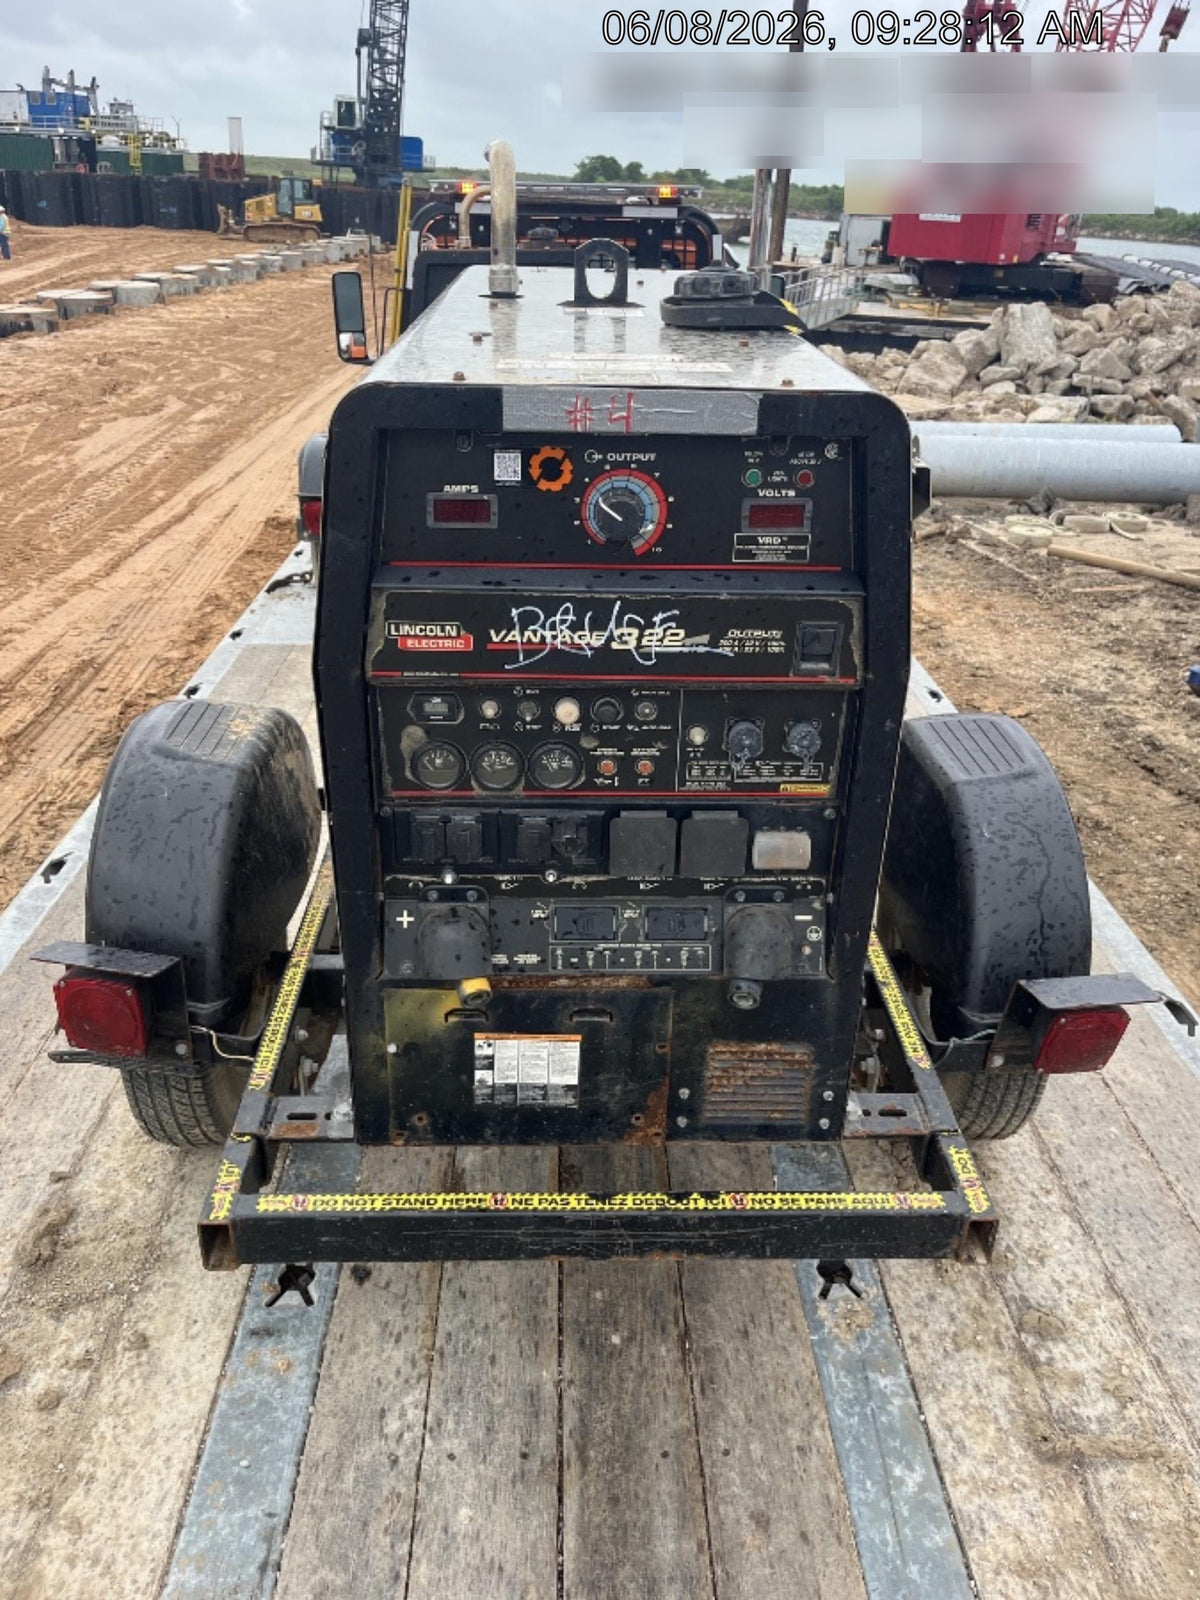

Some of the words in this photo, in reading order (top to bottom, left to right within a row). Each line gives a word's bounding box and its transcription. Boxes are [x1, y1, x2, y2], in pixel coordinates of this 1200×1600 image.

[606, 453, 656, 461] OUTPUT
[443, 484, 479, 493] AMPS
[757, 488, 796, 497] VOLTS
[390, 622, 457, 637] LINCOLN
[489, 628, 605, 645] VANTAGE
[611, 626, 686, 650] 322
[406, 638, 465, 648] ELECTRIC
[313, 1197, 337, 1206] DO
[342, 1197, 377, 1206] NOT
[382, 1197, 438, 1206] STAND
[442, 1197, 487, 1206] HERE
[512, 1197, 536, 1206] NE
[538, 1197, 570, 1206] PAS
[574, 1197, 629, 1206] TENEZ
[633, 1197, 699, 1206] DEBOUT
[702, 1197, 725, 1206] ICI
[751, 1197, 775, 1206] NO
[780, 1197, 799, 1206] SE
[804, 1197, 848, 1206] PARE
